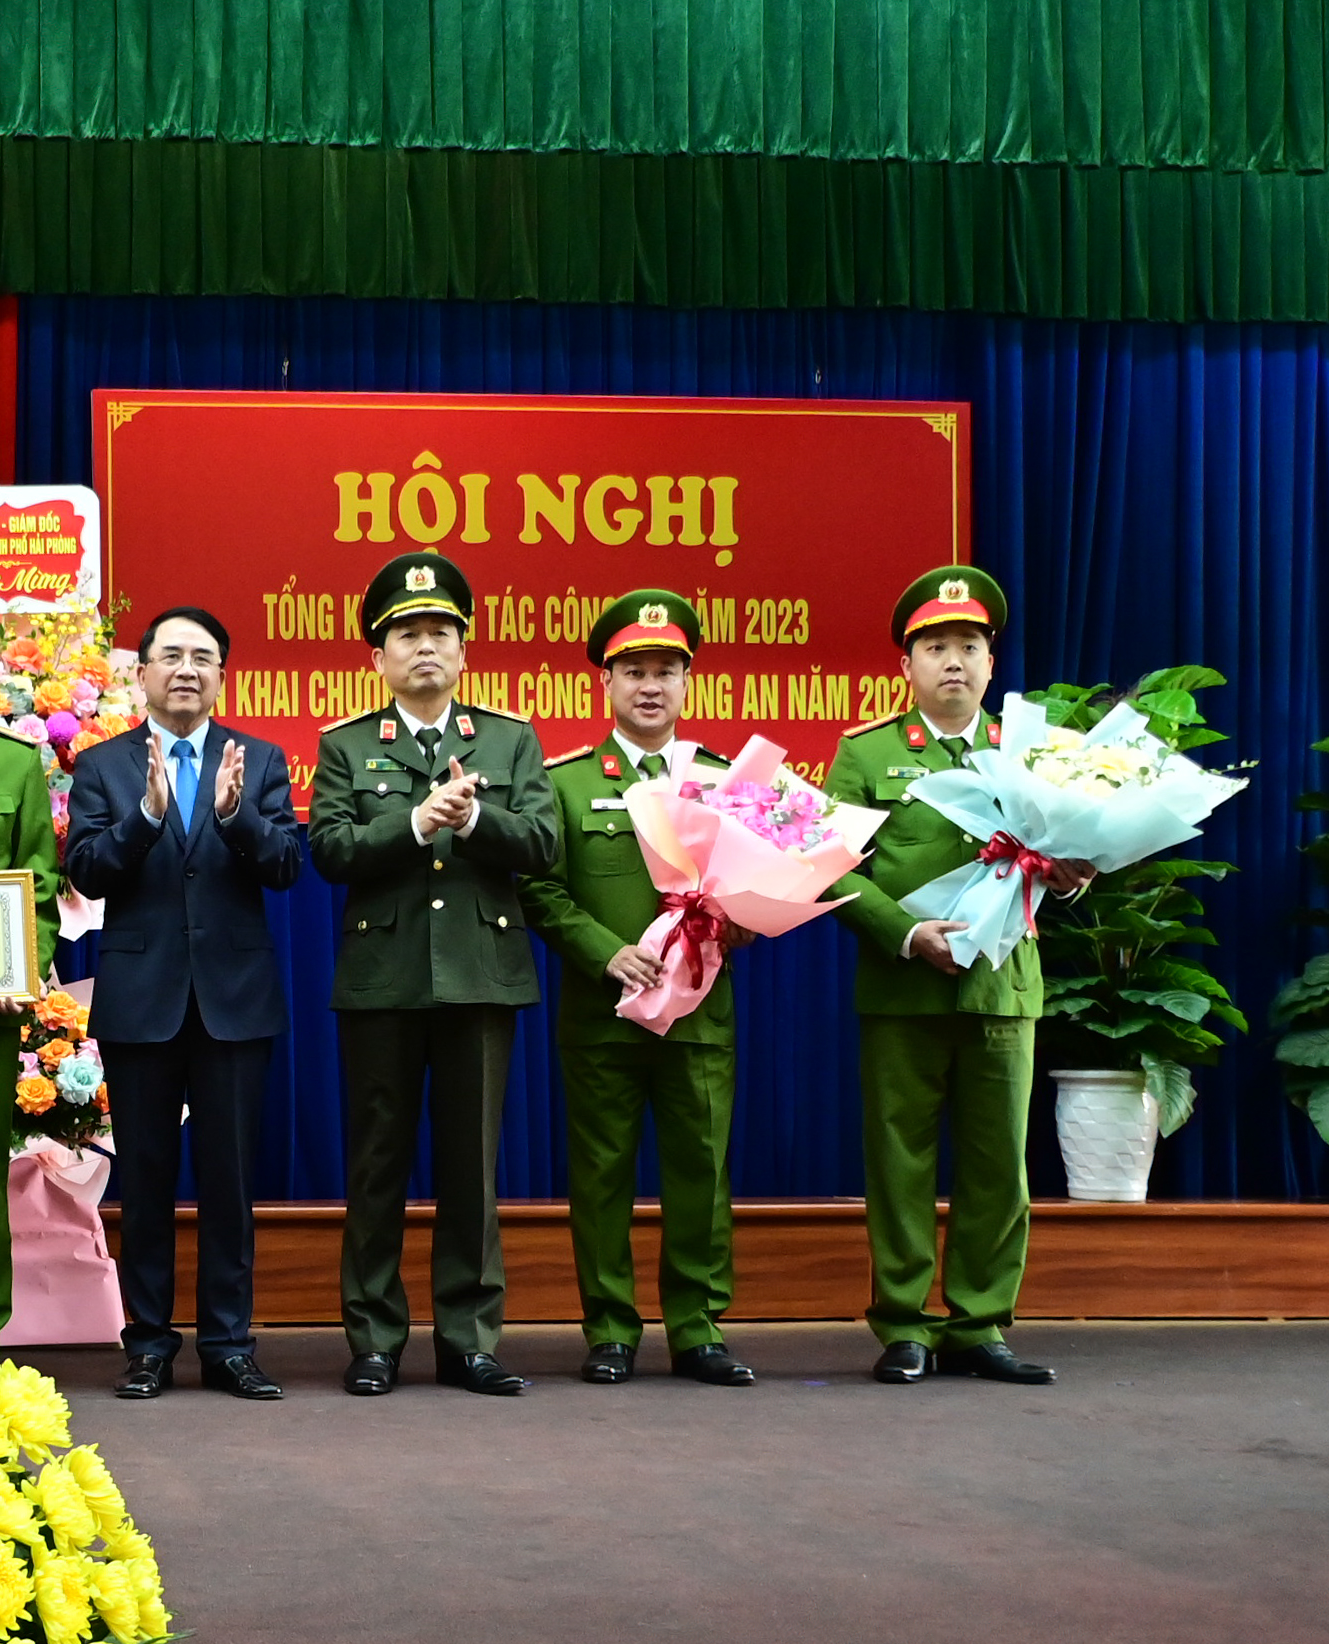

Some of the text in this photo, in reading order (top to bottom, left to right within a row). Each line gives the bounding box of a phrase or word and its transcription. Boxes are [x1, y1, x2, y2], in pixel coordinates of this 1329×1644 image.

[9, 513, 37, 533] GIÁM
[334, 450, 739, 567] HỘI NGHỊ
[263, 574, 336, 641] TỔNG
[485, 586, 535, 642] TÁC
[545, 586, 617, 643] CÔN
[687, 587, 736, 644] ĂM
[744, 597, 810, 645] 2023
[236, 670, 300, 718] KHAI
[518, 662, 592, 720] CÔNG
[741, 674, 779, 720] AN
[788, 664, 850, 721] NĂM
